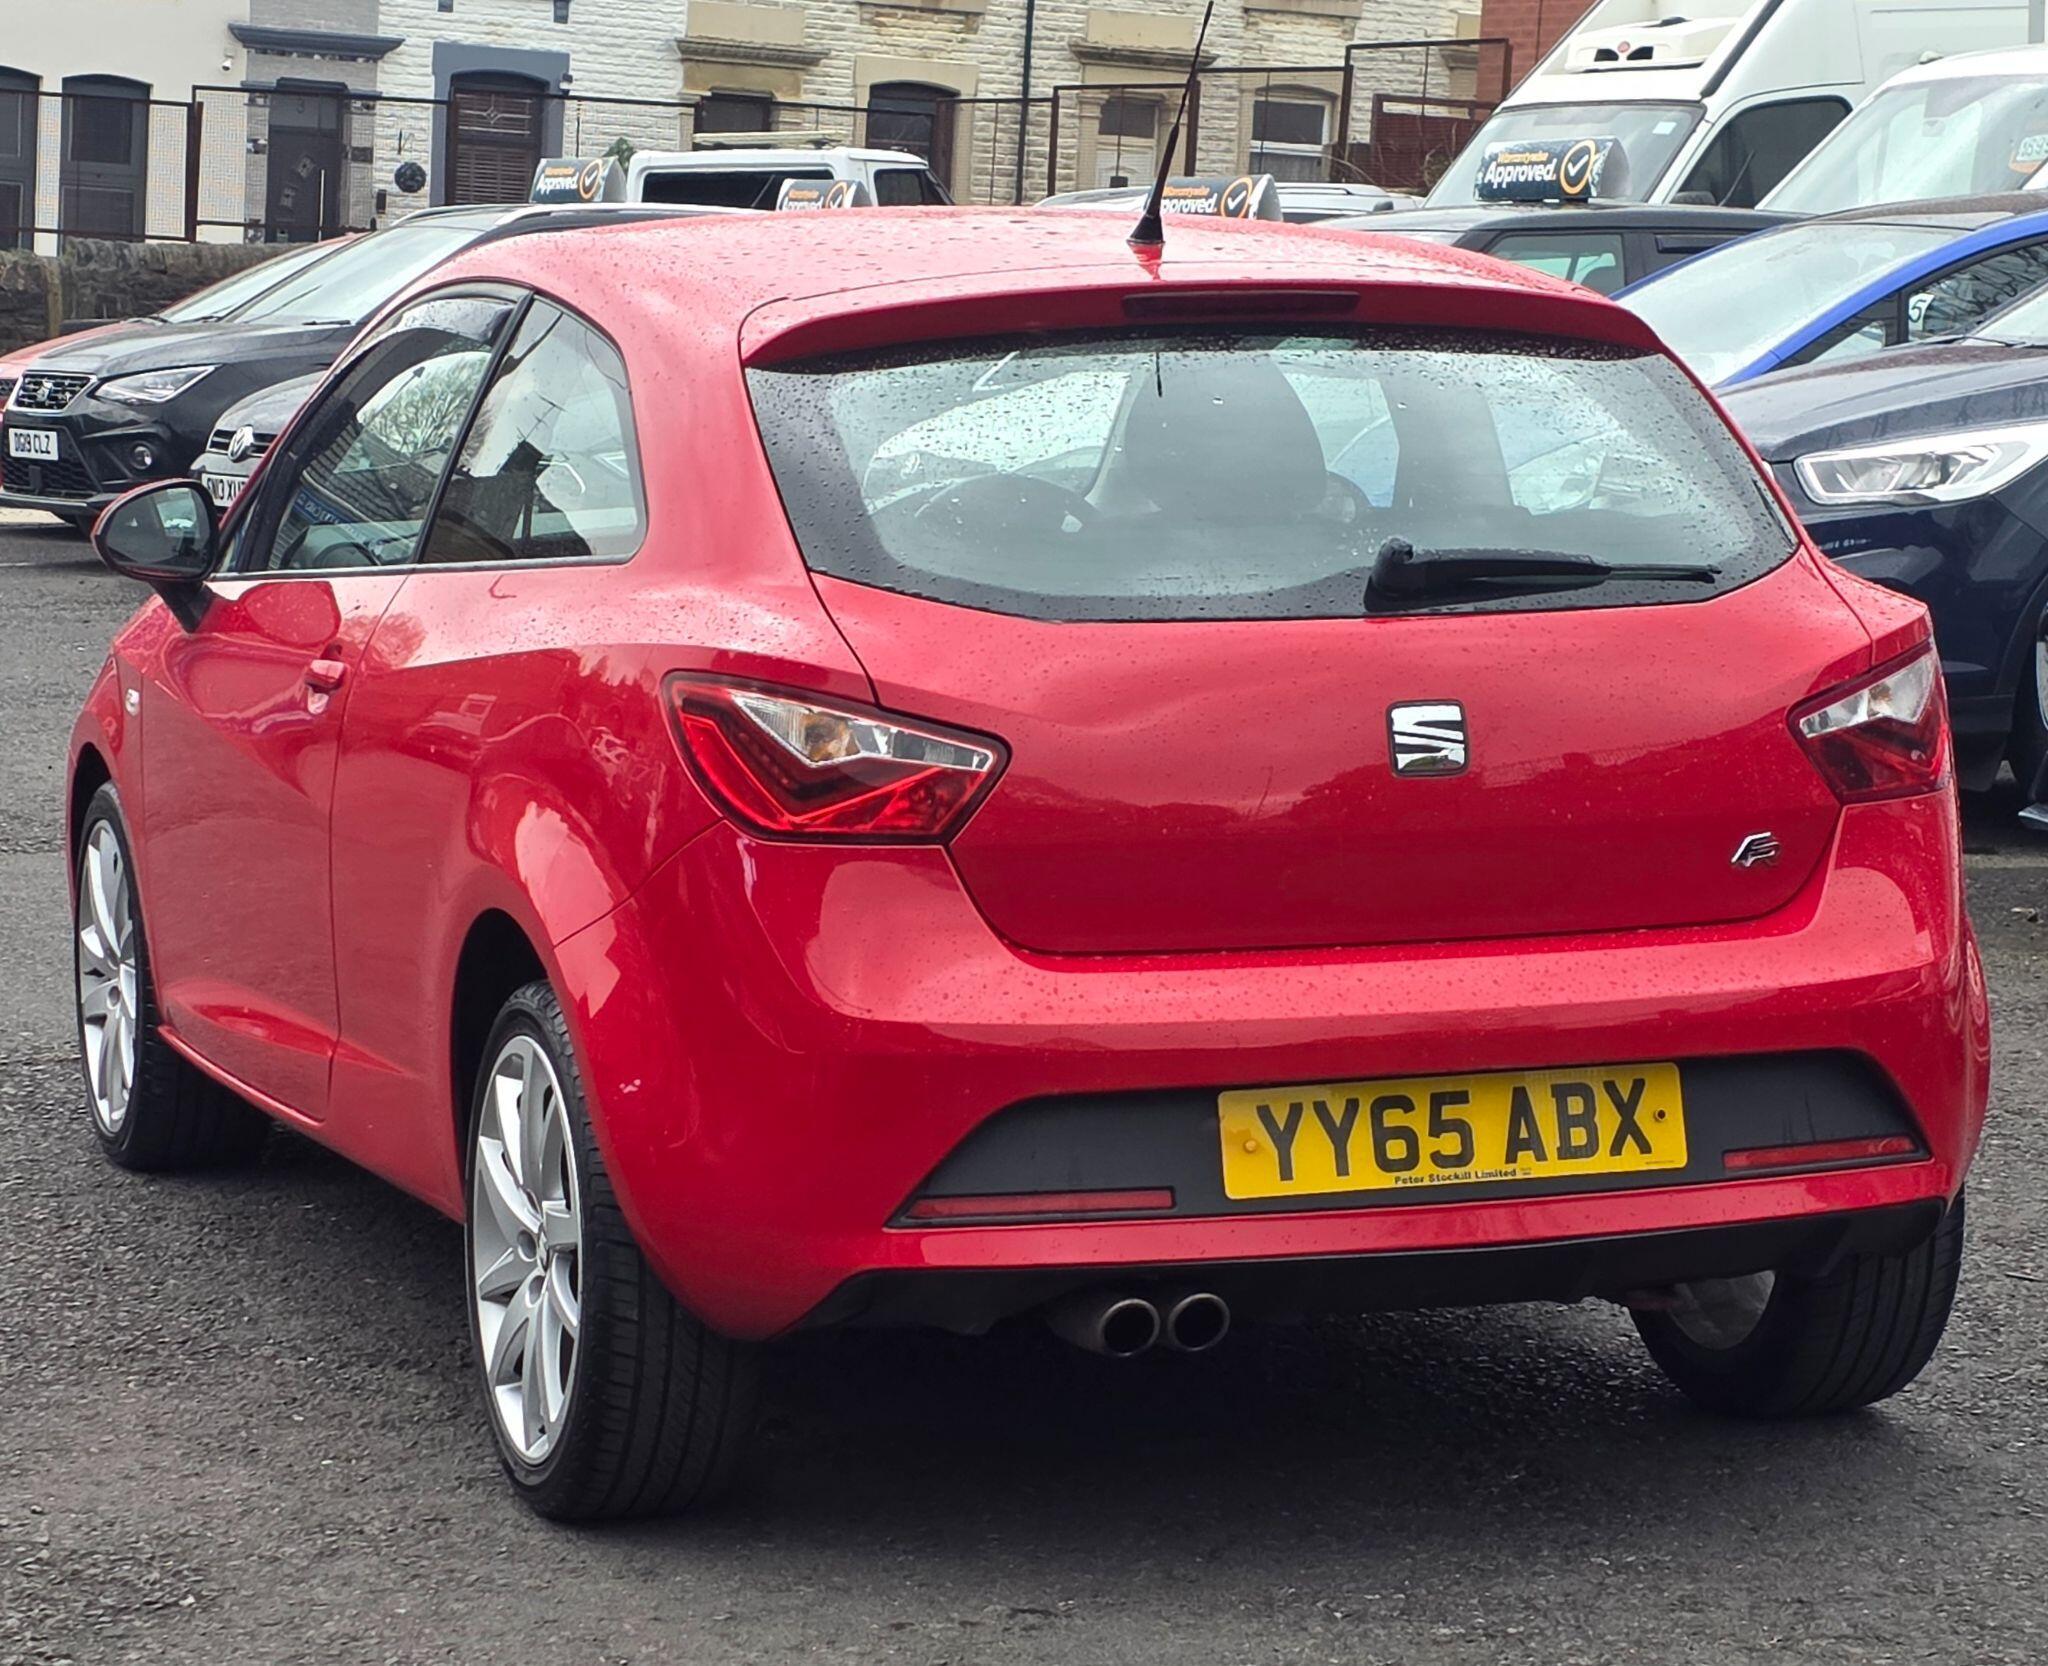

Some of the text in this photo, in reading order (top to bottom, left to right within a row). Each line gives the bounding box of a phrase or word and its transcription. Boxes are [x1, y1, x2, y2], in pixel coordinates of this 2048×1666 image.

[1161, 192, 1218, 214] pproved.
[33, 434, 51, 455] CLZ
[1256, 1077, 1653, 1182] YY65 ABX
[1394, 1174, 1425, 1185] Peter
[1474, 1167, 1517, 1180] Limited
